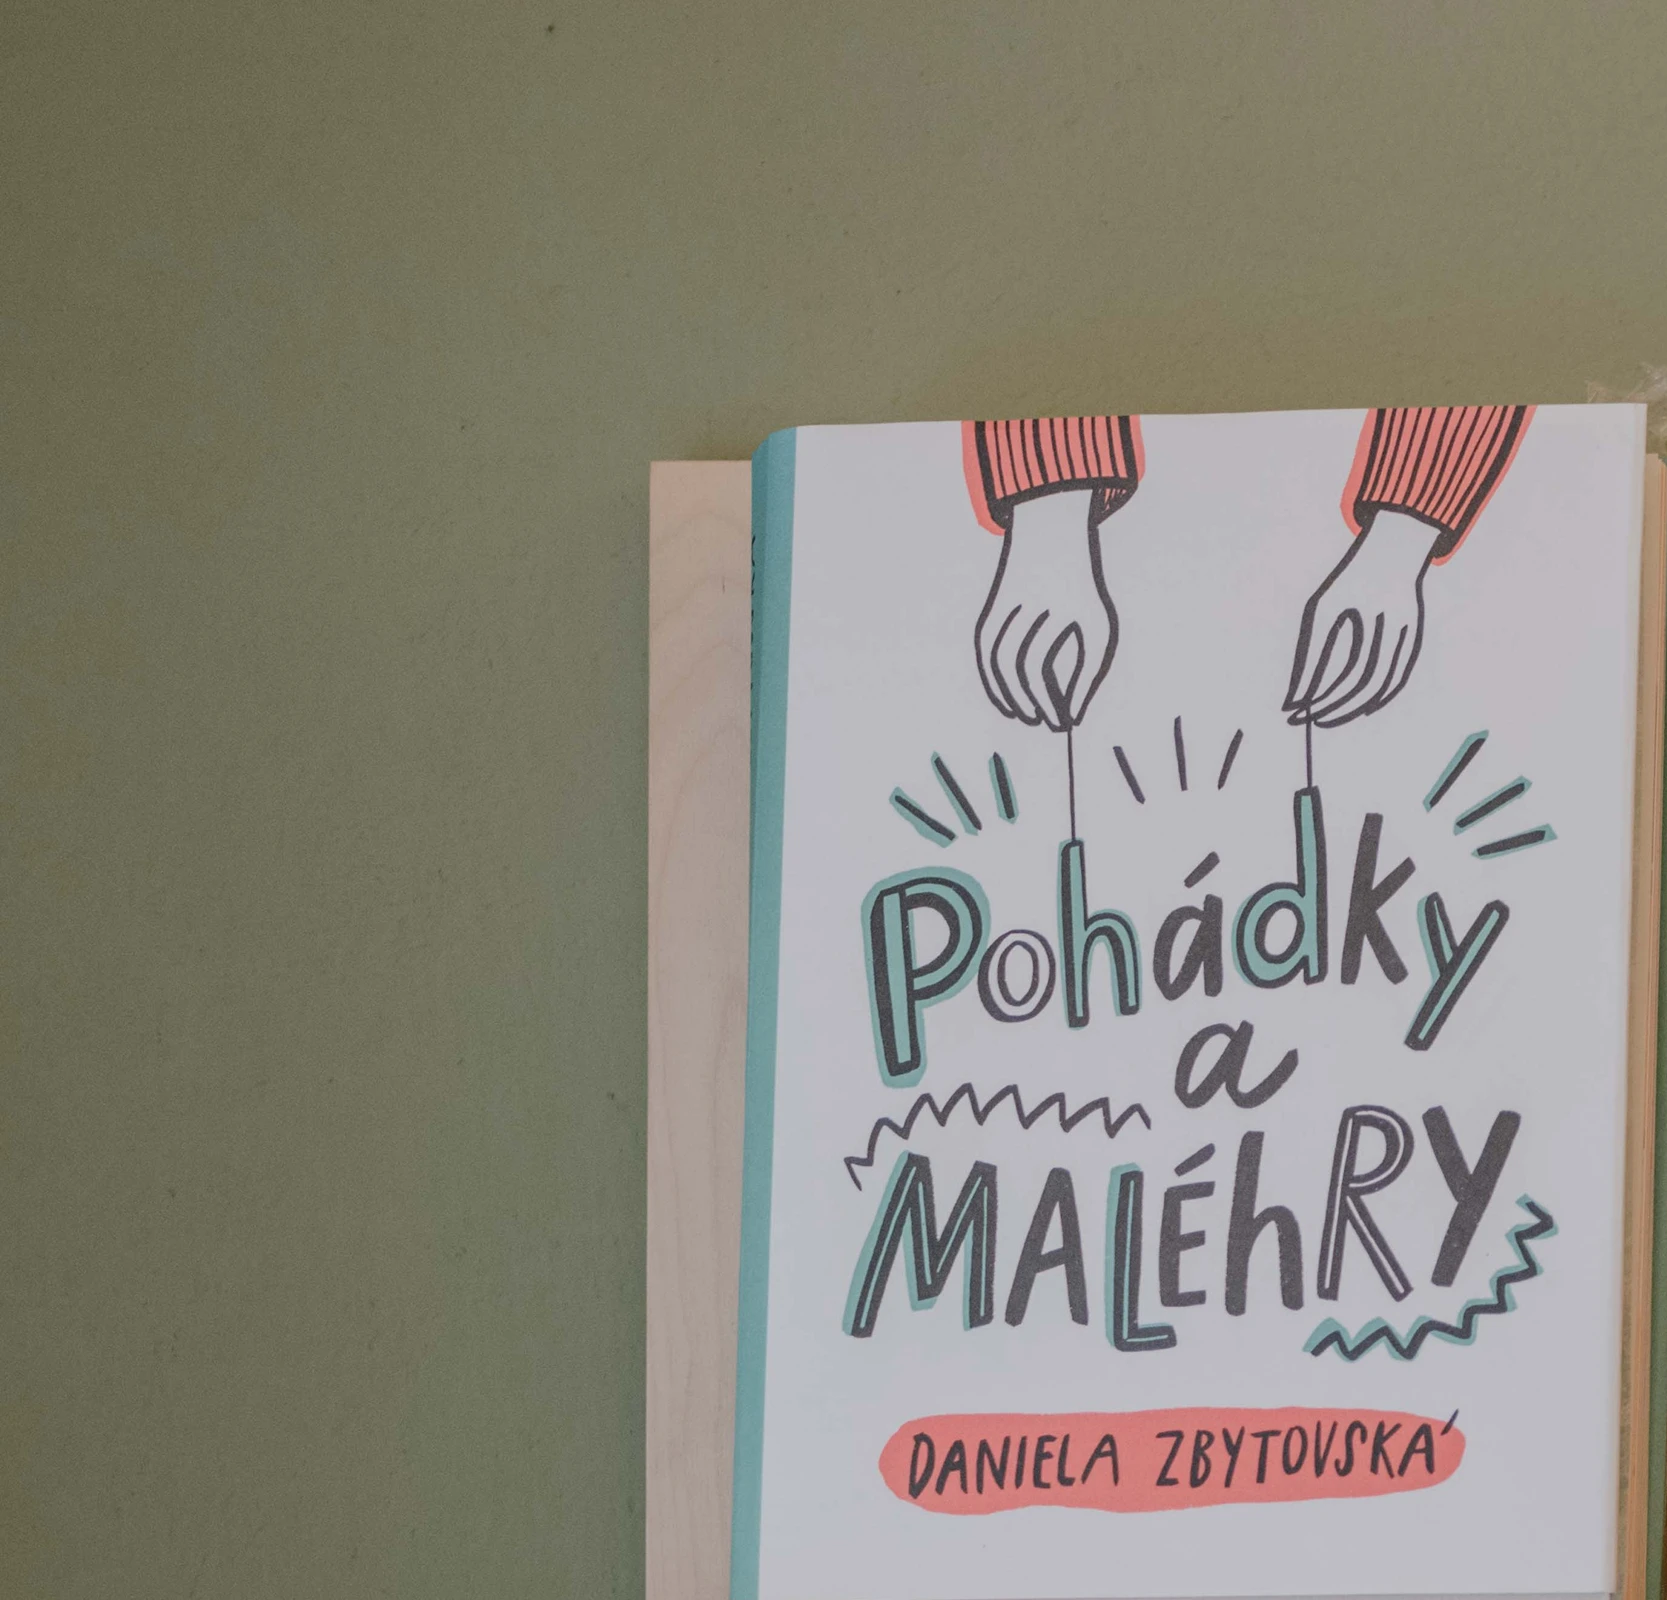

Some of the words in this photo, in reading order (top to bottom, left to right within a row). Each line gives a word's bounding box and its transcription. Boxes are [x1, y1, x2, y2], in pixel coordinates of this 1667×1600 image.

[860, 786, 1511, 1088] Pohádky
[1173, 1019, 1300, 1110] a
[906, 1430, 1120, 1501] DANIELA
[1155, 1408, 1460, 1490] ZBYTOVSKÁ
